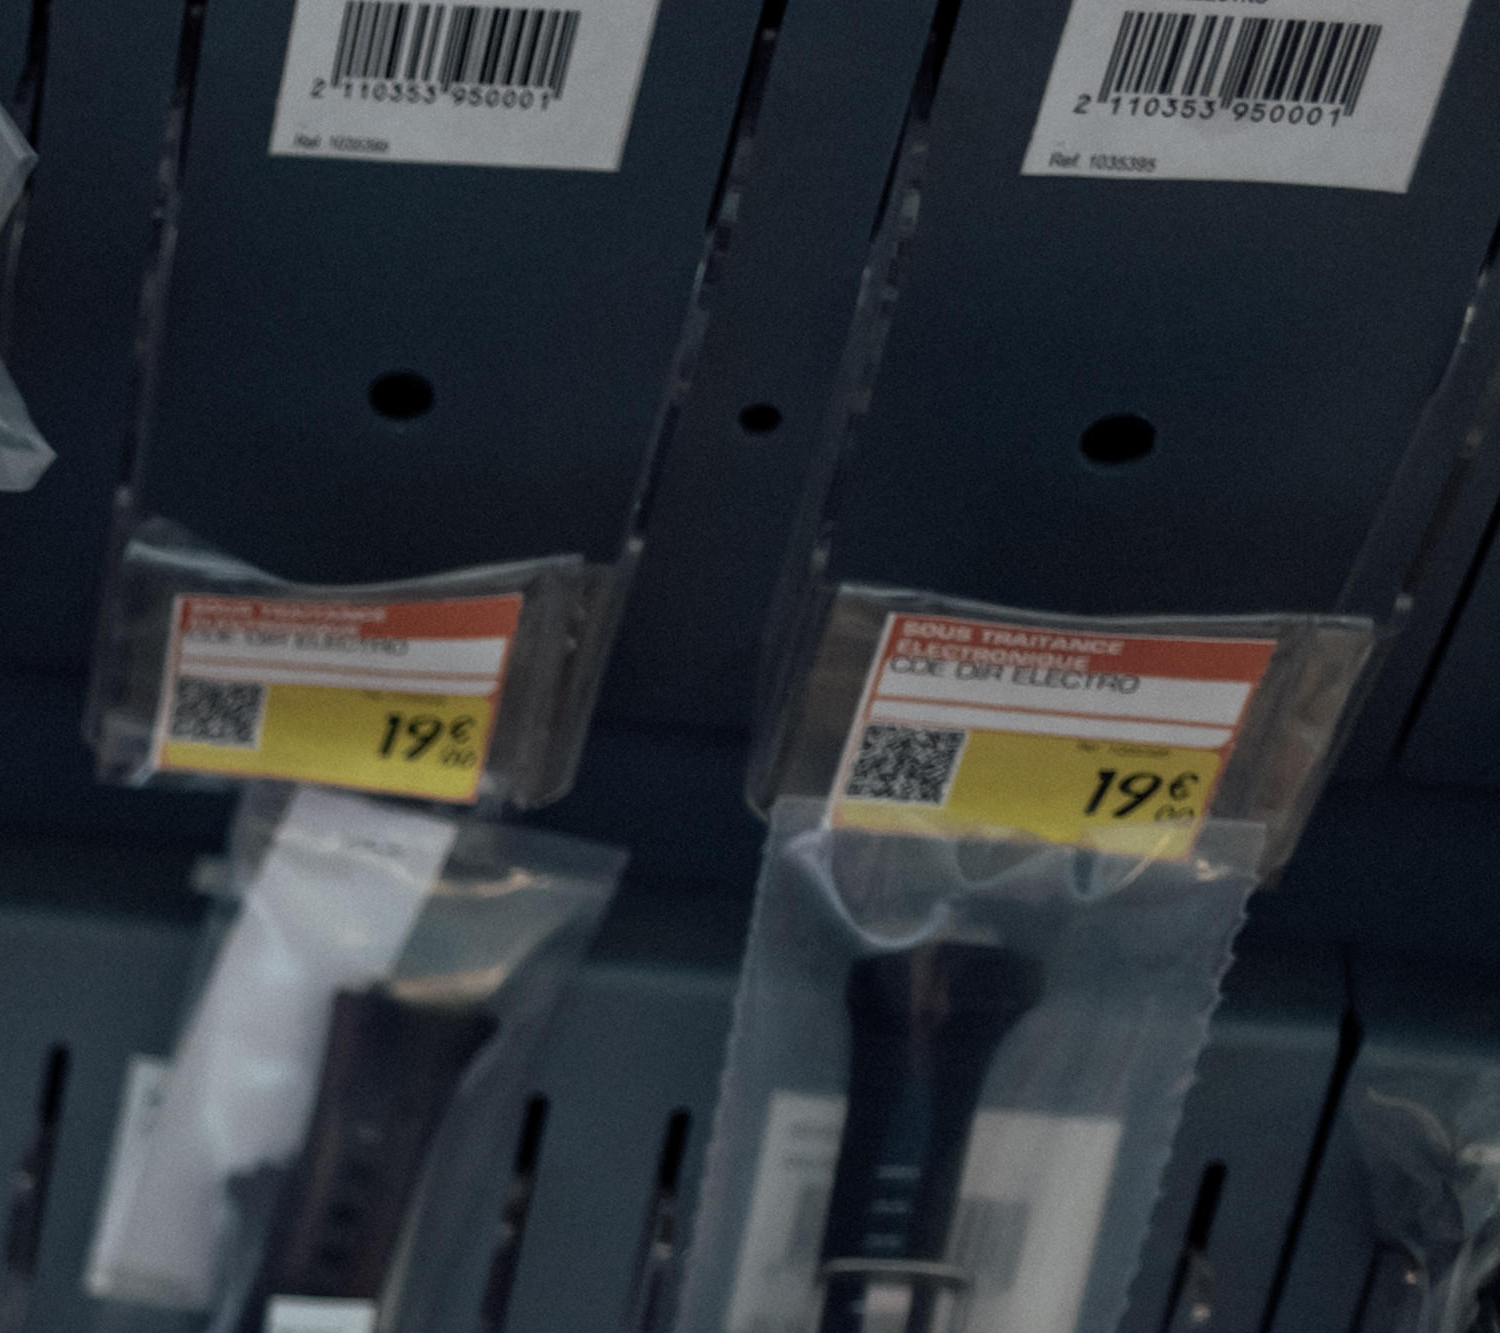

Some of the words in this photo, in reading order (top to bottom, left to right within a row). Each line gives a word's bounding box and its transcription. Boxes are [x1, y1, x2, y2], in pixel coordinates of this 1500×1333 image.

[451, 85, 550, 112] 950001
[1072, 94, 1092, 115] 2
[1109, 97, 1216, 120] 110353
[1232, 102, 1342, 127] 950001
